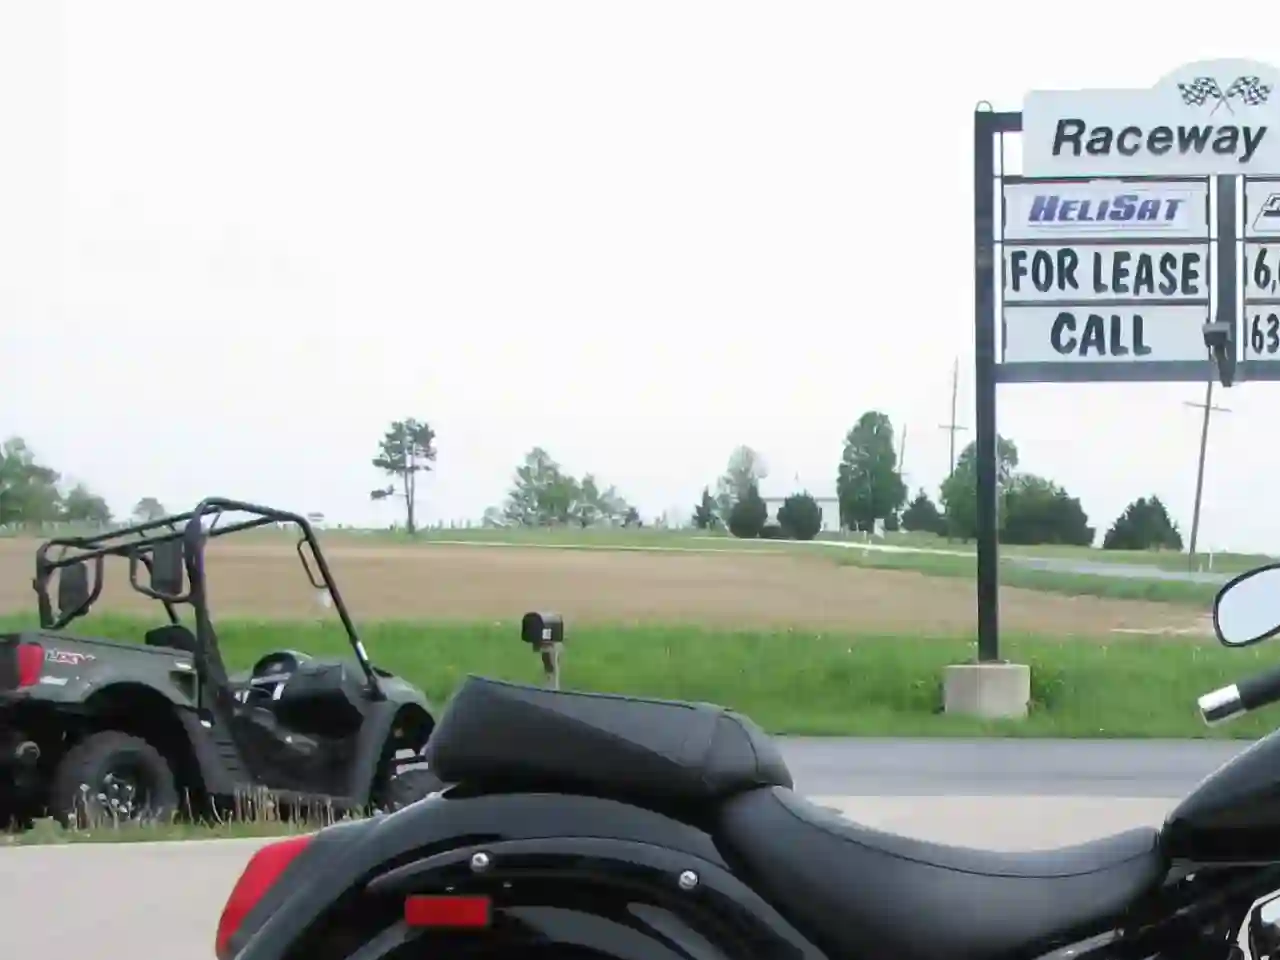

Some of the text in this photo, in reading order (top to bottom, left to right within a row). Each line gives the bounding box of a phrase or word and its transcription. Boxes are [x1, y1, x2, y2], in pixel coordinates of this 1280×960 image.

[1052, 118, 1267, 163] Raceway
[1011, 248, 1200, 296] FOR LEASE
[1050, 312, 1152, 356] CALL
